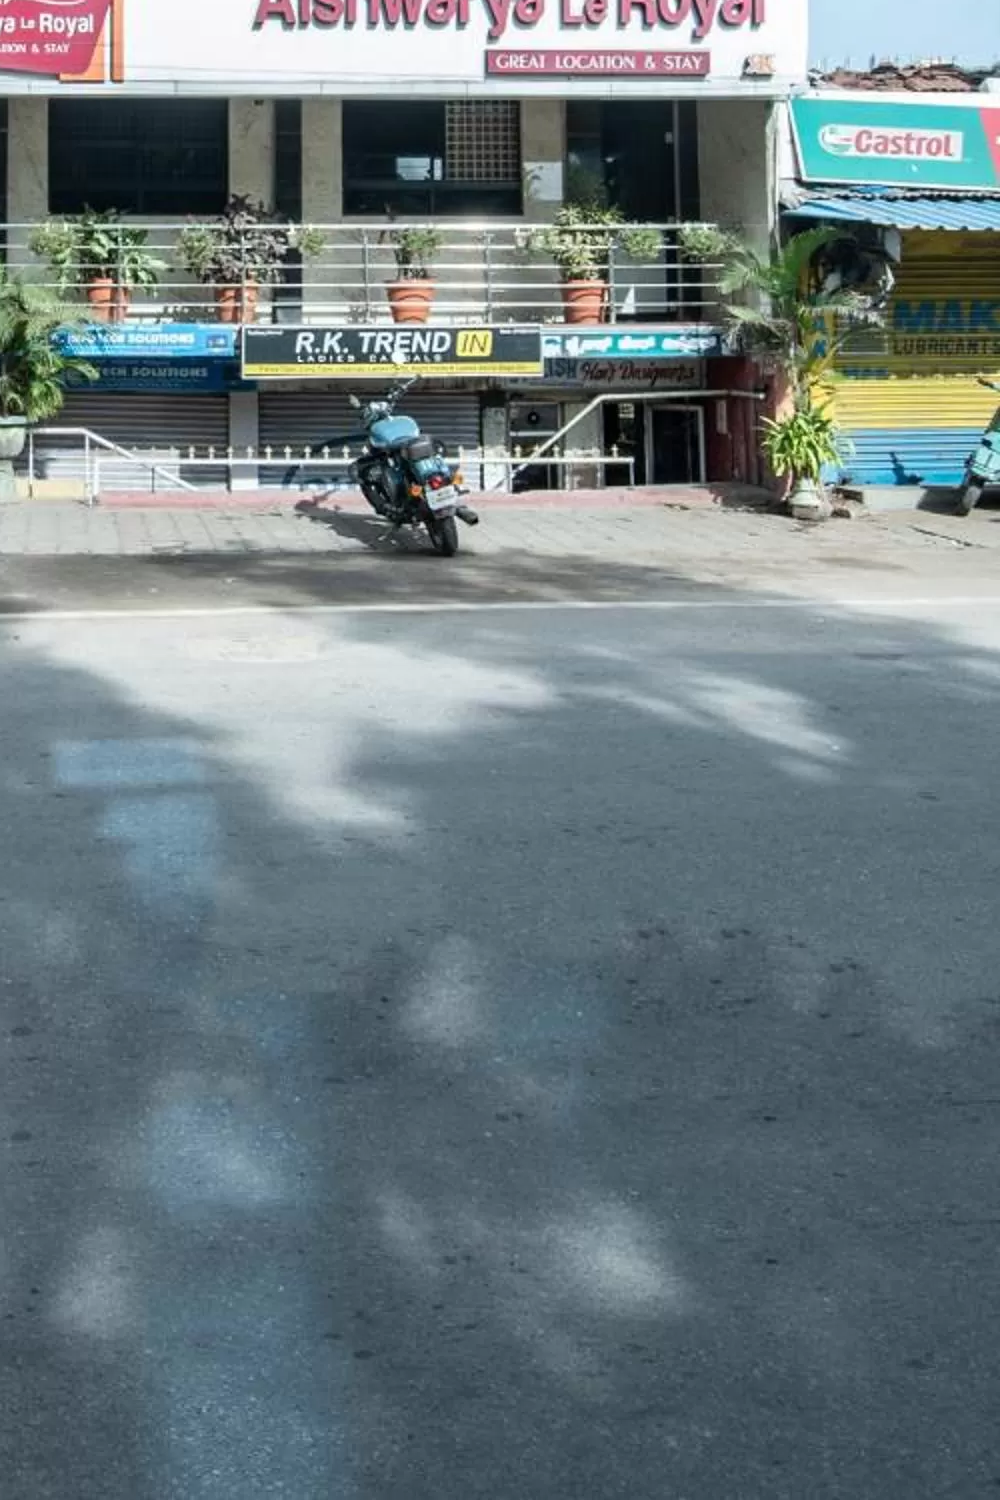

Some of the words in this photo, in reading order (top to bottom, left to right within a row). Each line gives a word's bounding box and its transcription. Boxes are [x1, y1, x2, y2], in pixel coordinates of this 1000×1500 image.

[20, 17, 36, 29] Le
[39, 13, 94, 38] Royal
[31, 43, 40, 53] &
[43, 43, 70, 53] STAY
[496, 54, 545, 69] GREAT
[555, 54, 635, 70] LOCATION
[644, 55, 655, 69] &
[663, 55, 702, 70] STAY
[854, 129, 954, 157] Castrol
[893, 301, 1000, 333] MAK
[295, 331, 349, 354] R.K.
[359, 331, 451, 354] TREND
[461, 333, 489, 354] IN
